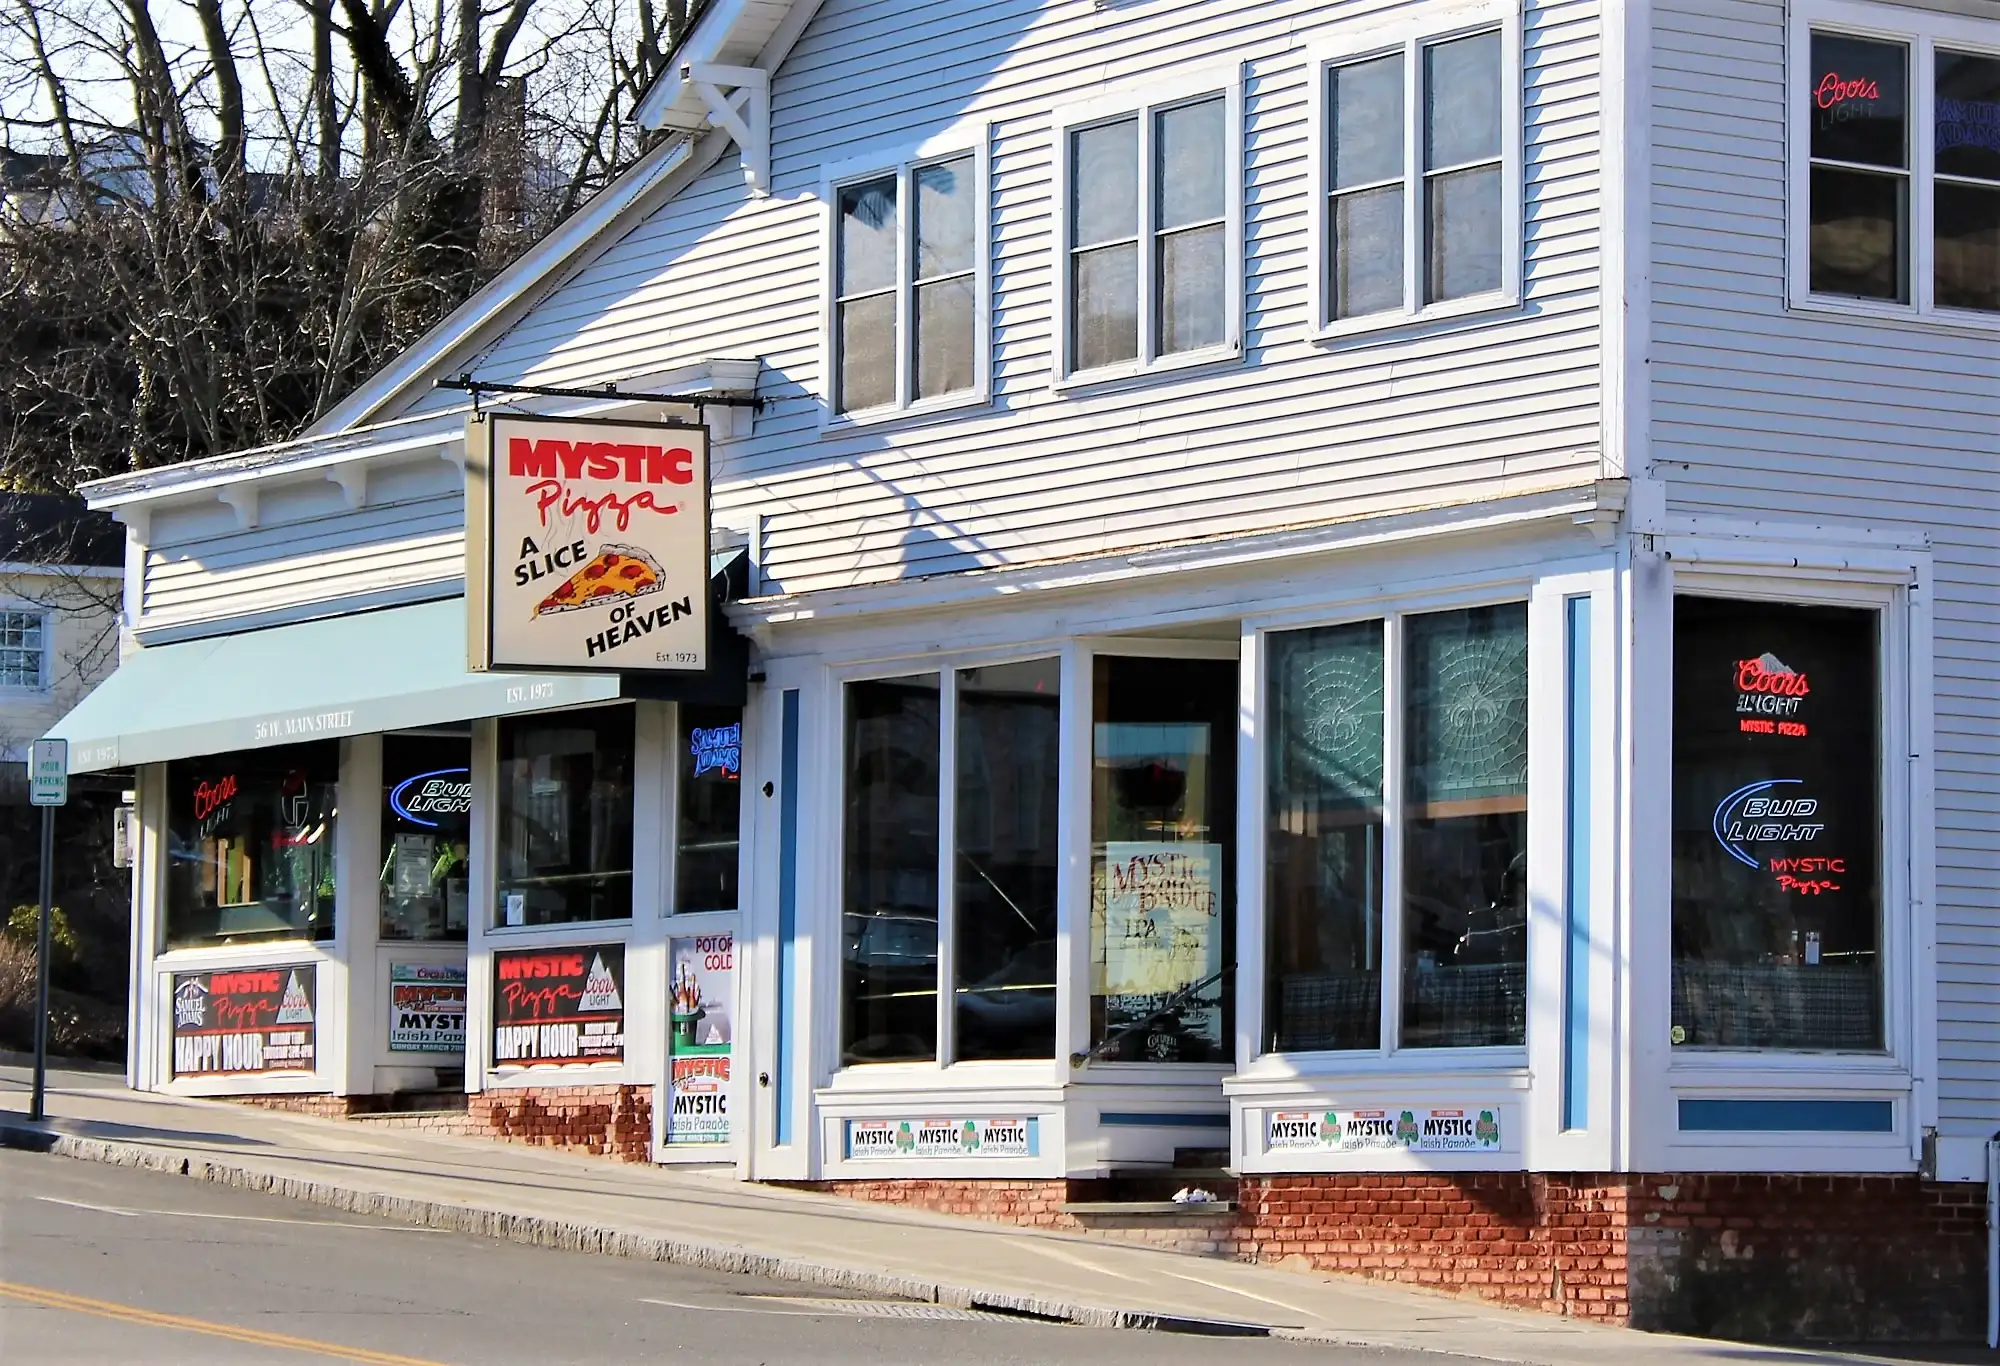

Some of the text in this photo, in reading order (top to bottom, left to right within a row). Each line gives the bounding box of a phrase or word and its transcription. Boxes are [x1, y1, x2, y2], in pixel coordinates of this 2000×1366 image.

[1813, 72, 1881, 109] Coors
[1821, 103, 1875, 131] LIGHT
[509, 438, 693, 484] MYSTIC
[525, 480, 678, 534] Pizza
[519, 536, 540, 560] A
[514, 540, 588, 586] SLICE
[609, 601, 636, 624] OF
[586, 596, 692, 657] HEAVEN
[656, 652, 698, 663] Est. 1973
[1739, 657, 1810, 696] Coors
[530, 682, 554, 700] 1973
[1737, 694, 1803, 716] LIGHT
[255, 721, 268, 740] 56
[285, 715, 314, 734] MAIN
[315, 710, 354, 732] STREET
[1740, 719, 1808, 737] MYSTIC PIZZA
[691, 722, 742, 755] SAMUEL
[48, 746, 53, 757] 2
[40, 761, 60, 772] HOUR
[694, 747, 739, 778] ADAMS
[34, 776, 64, 787] PARKING
[194, 774, 238, 820] Coors
[406, 795, 472, 813] LIGH
[1743, 797, 1818, 818] BUD
[1727, 820, 1825, 842] LIGHT
[1770, 857, 1846, 874] MYSTIC
[1775, 873, 1841, 895] Pizza
[696, 937, 717, 954] POT
[499, 954, 585, 980] MYSTIC
[210, 970, 281, 995] MYSTIC
[175, 996, 206, 1015] SAMUEL
[502, 981, 582, 1017] Pizza
[589, 994, 610, 1006] LIGHT
[177, 1008, 204, 1029] ADAMS
[213, 995, 279, 1029] Pizza
[399, 1013, 466, 1029] MYST
[392, 1029, 466, 1041] Irish Par
[496, 1022, 579, 1060] HAPPY HOUR
[175, 1034, 220, 1073] HAPPY
[222, 1032, 264, 1071] HOUR
[672, 1056, 731, 1082] MYSTIC
[673, 1094, 727, 1115] MYSTIC
[693, 1115, 730, 1131] Parade
[1271, 1121, 1318, 1138] MYSTIC
[1346, 1119, 1394, 1136] MYSTIC
[1423, 1119, 1473, 1136] MYSTIC
[855, 1130, 894, 1145] MYSTIC
[919, 1129, 958, 1144] MYSTIC
[984, 1127, 1024, 1143] MYSTIC
[1364, 1138, 1397, 1149] Parade
[1420, 1137, 1476, 1149] Irish Parade
